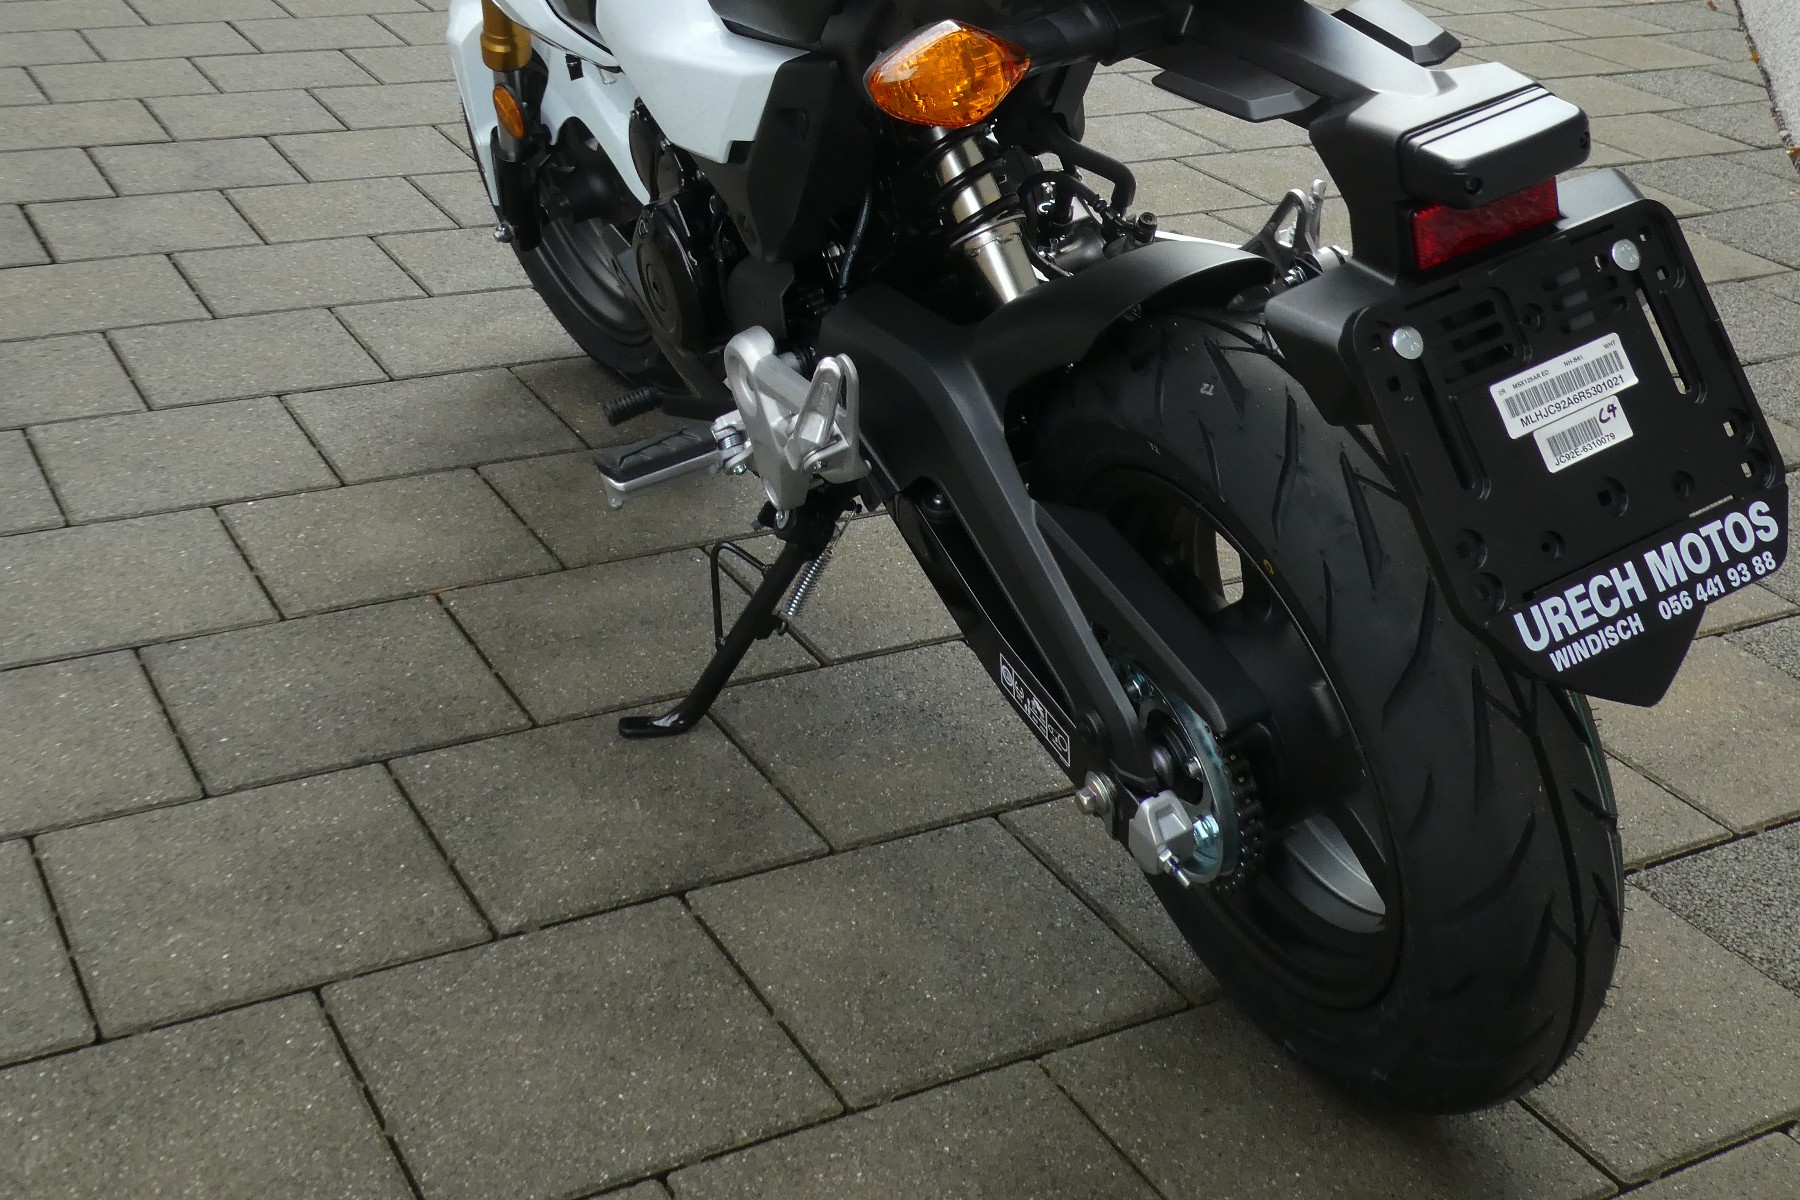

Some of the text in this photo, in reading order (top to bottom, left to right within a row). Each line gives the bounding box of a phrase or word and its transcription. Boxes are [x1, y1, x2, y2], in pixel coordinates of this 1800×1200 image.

[1603, 340, 1617, 349] WHT
[1520, 374, 1625, 427] MLHJC92A6R5301021
[1555, 432, 1616, 466] JC92E-6310079
[1514, 500, 1778, 651] URECH MOTOS
[1549, 550, 1777, 672] WINDISCH 056 441 93 88
